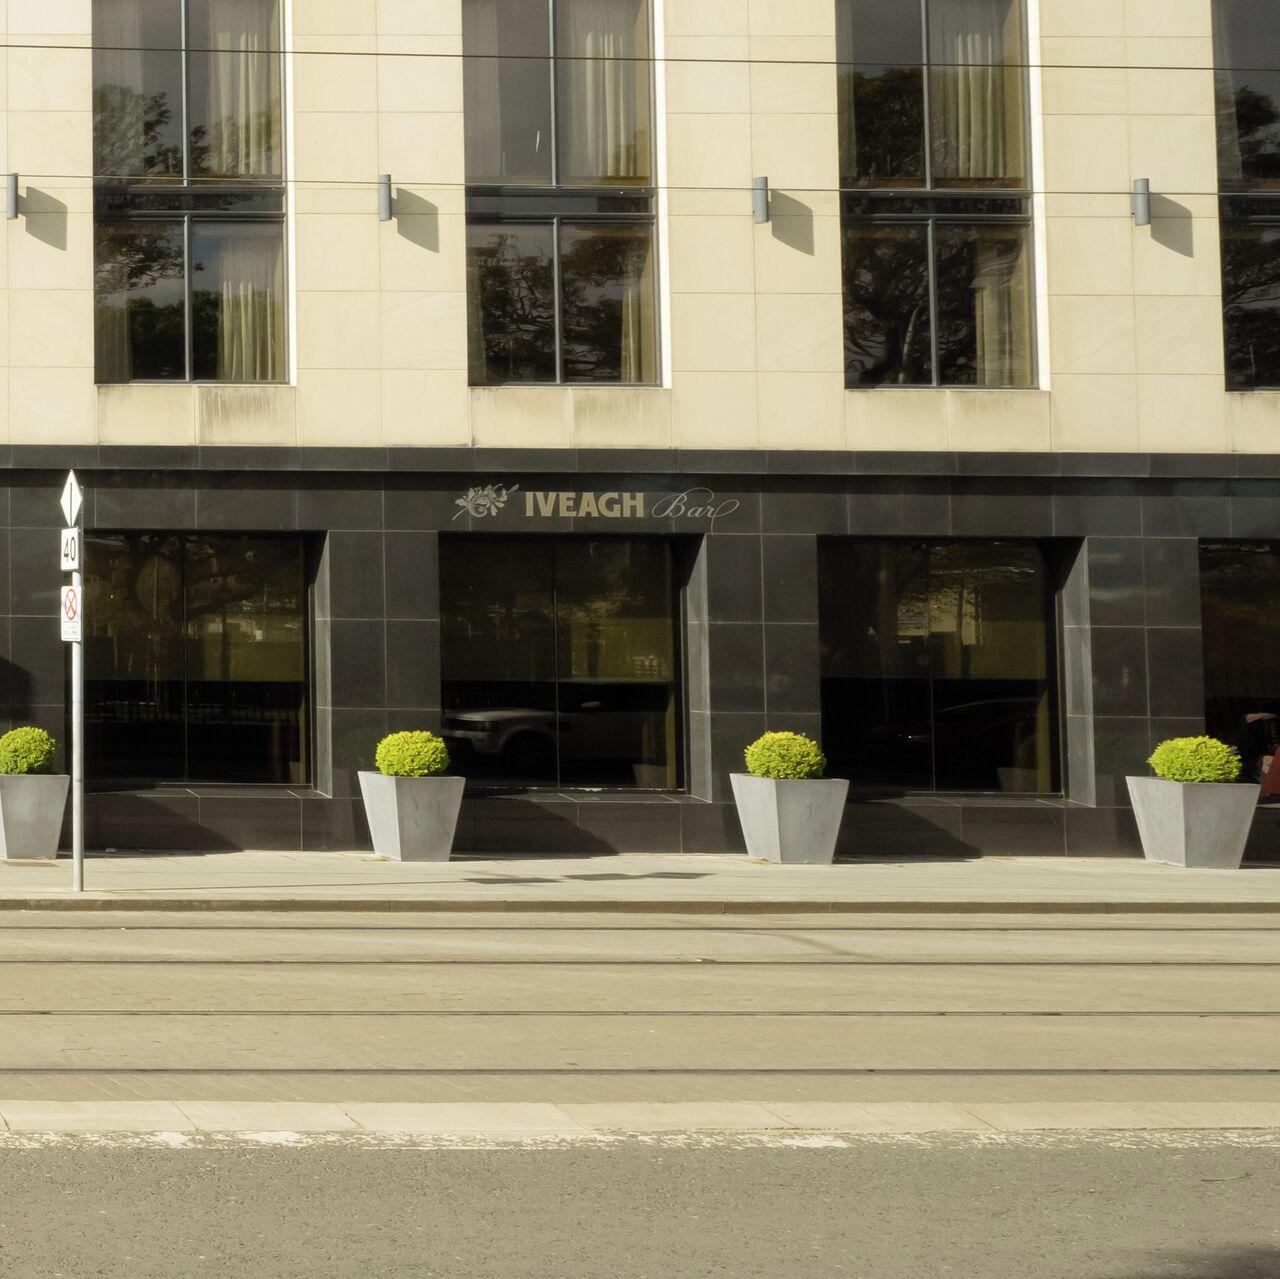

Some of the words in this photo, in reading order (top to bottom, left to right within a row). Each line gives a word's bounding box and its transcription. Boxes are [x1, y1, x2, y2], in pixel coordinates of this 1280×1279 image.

[525, 491, 645, 518] IVEAGH
[651, 487, 739, 534] Bar
[63, 536, 76, 562] 40
